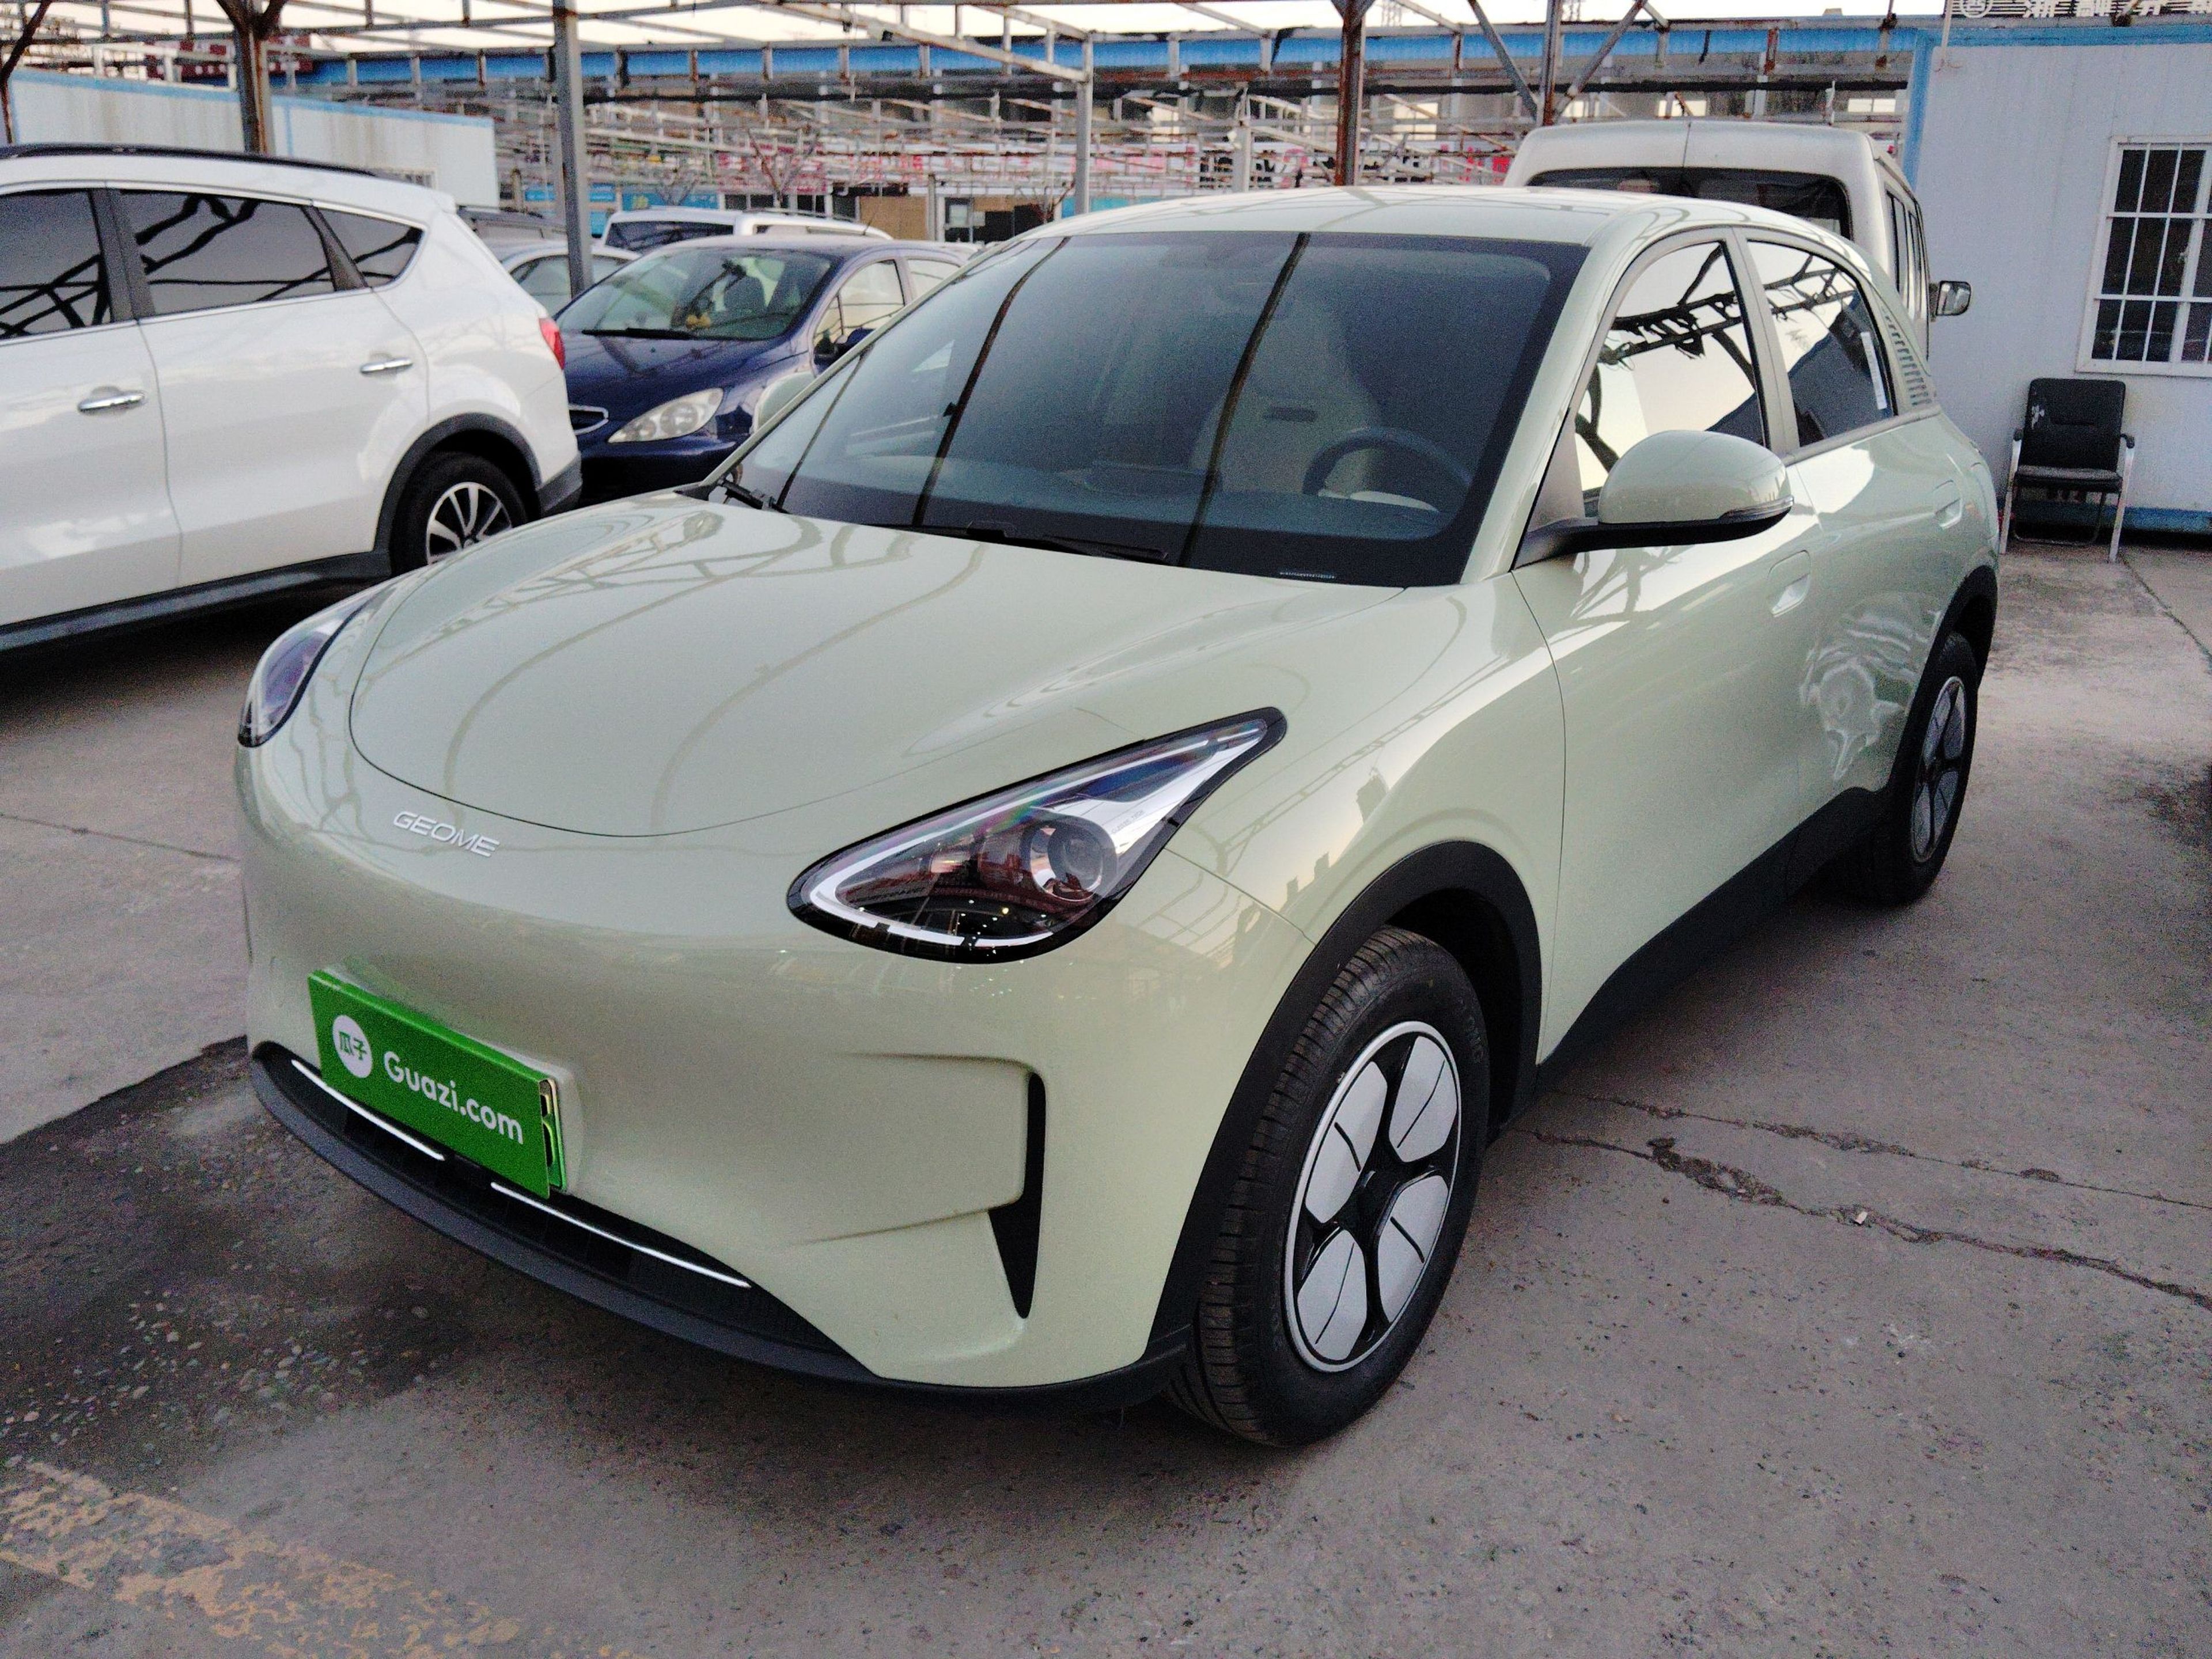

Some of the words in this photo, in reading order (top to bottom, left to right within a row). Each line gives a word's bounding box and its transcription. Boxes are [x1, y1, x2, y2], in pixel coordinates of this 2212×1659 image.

[393, 811, 501, 857] GEOME
[338, 1031, 368, 1061] 瓜子
[384, 1051, 524, 1145] Guazi.com
